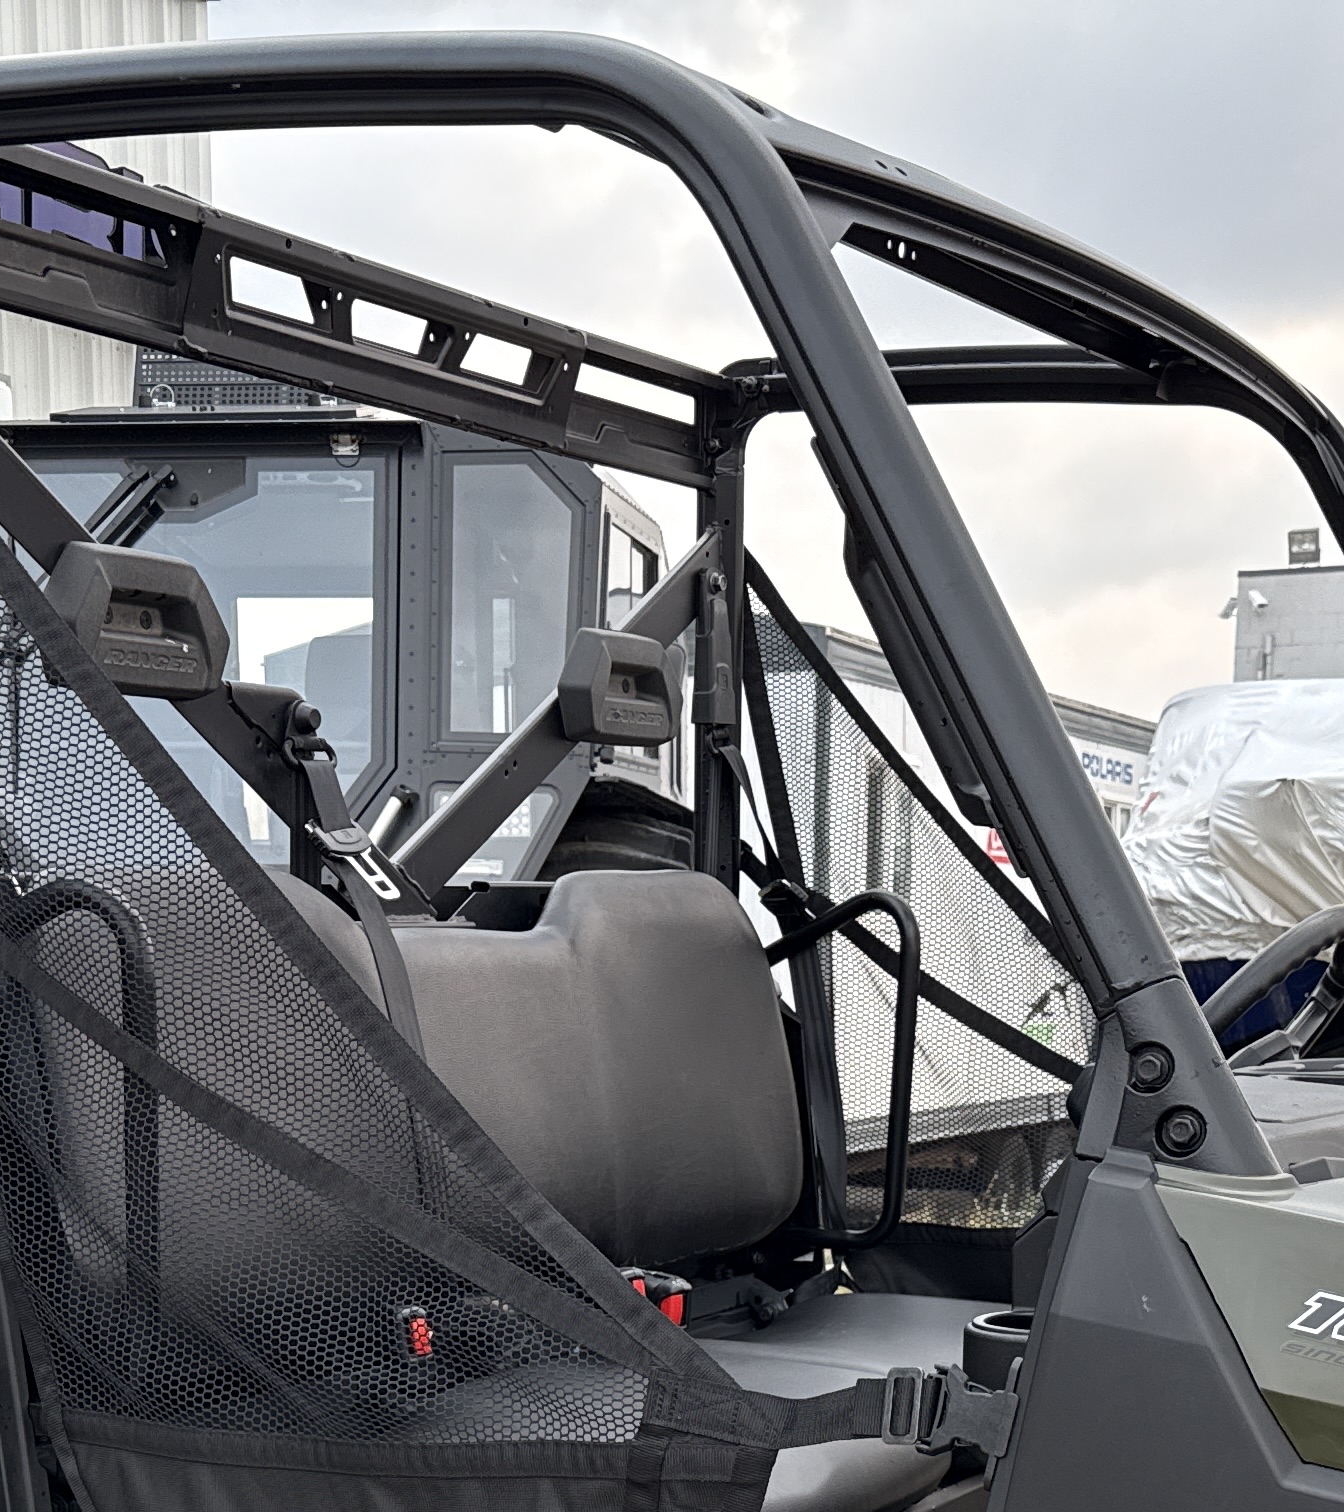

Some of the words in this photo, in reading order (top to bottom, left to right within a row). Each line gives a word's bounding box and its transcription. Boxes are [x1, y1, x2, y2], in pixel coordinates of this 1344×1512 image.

[103, 648, 198, 674] RANGER
[606, 708, 664, 727] RANGER
[1082, 752, 1134, 786] POLARIS
